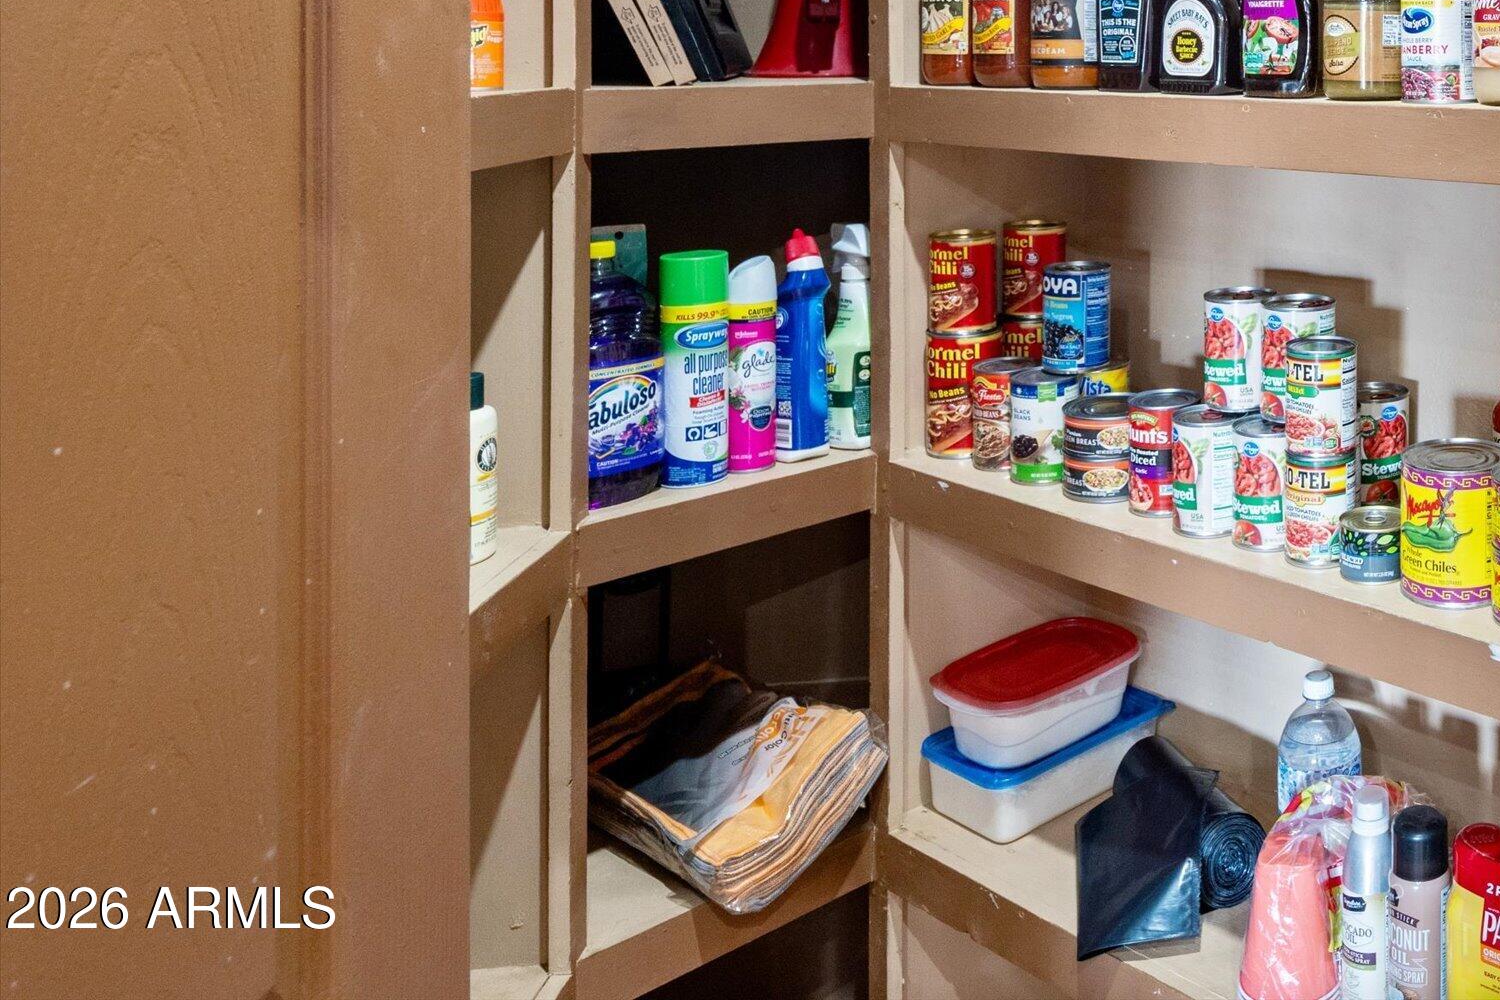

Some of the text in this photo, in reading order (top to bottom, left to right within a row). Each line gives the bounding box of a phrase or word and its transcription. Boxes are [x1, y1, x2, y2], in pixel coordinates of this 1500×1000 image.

[1247, 0, 1286, 9] VINAIGRETTE
[1182, 8, 1194, 18] BABY
[1101, 18, 1137, 27] THIS IS THE
[1102, 28, 1135, 36] ORIGINAL
[1177, 36, 1197, 48] Honey
[747, 306, 774, 316] CAUTION
[675, 313, 696, 321] KILLS
[684, 352, 697, 375] all
[928, 360, 967, 379] Chili
[692, 372, 725, 396] cleaner
[938, 386, 966, 398] Beans
[1240, 386, 1254, 394] USA
[1076, 437, 1101, 447] BREAST
[596, 459, 619, 468] CAUTION
[1130, 452, 1157, 467] Diced
[1190, 512, 1204, 520] USA
[1424, 558, 1458, 574] Chiles
[1486, 882, 1495, 895] 2
[1395, 911, 1415, 926] STICK
[1391, 950, 1410, 966] OIL
[1402, 969, 1426, 984] SPRAY
[1483, 970, 1497, 981] EASY
